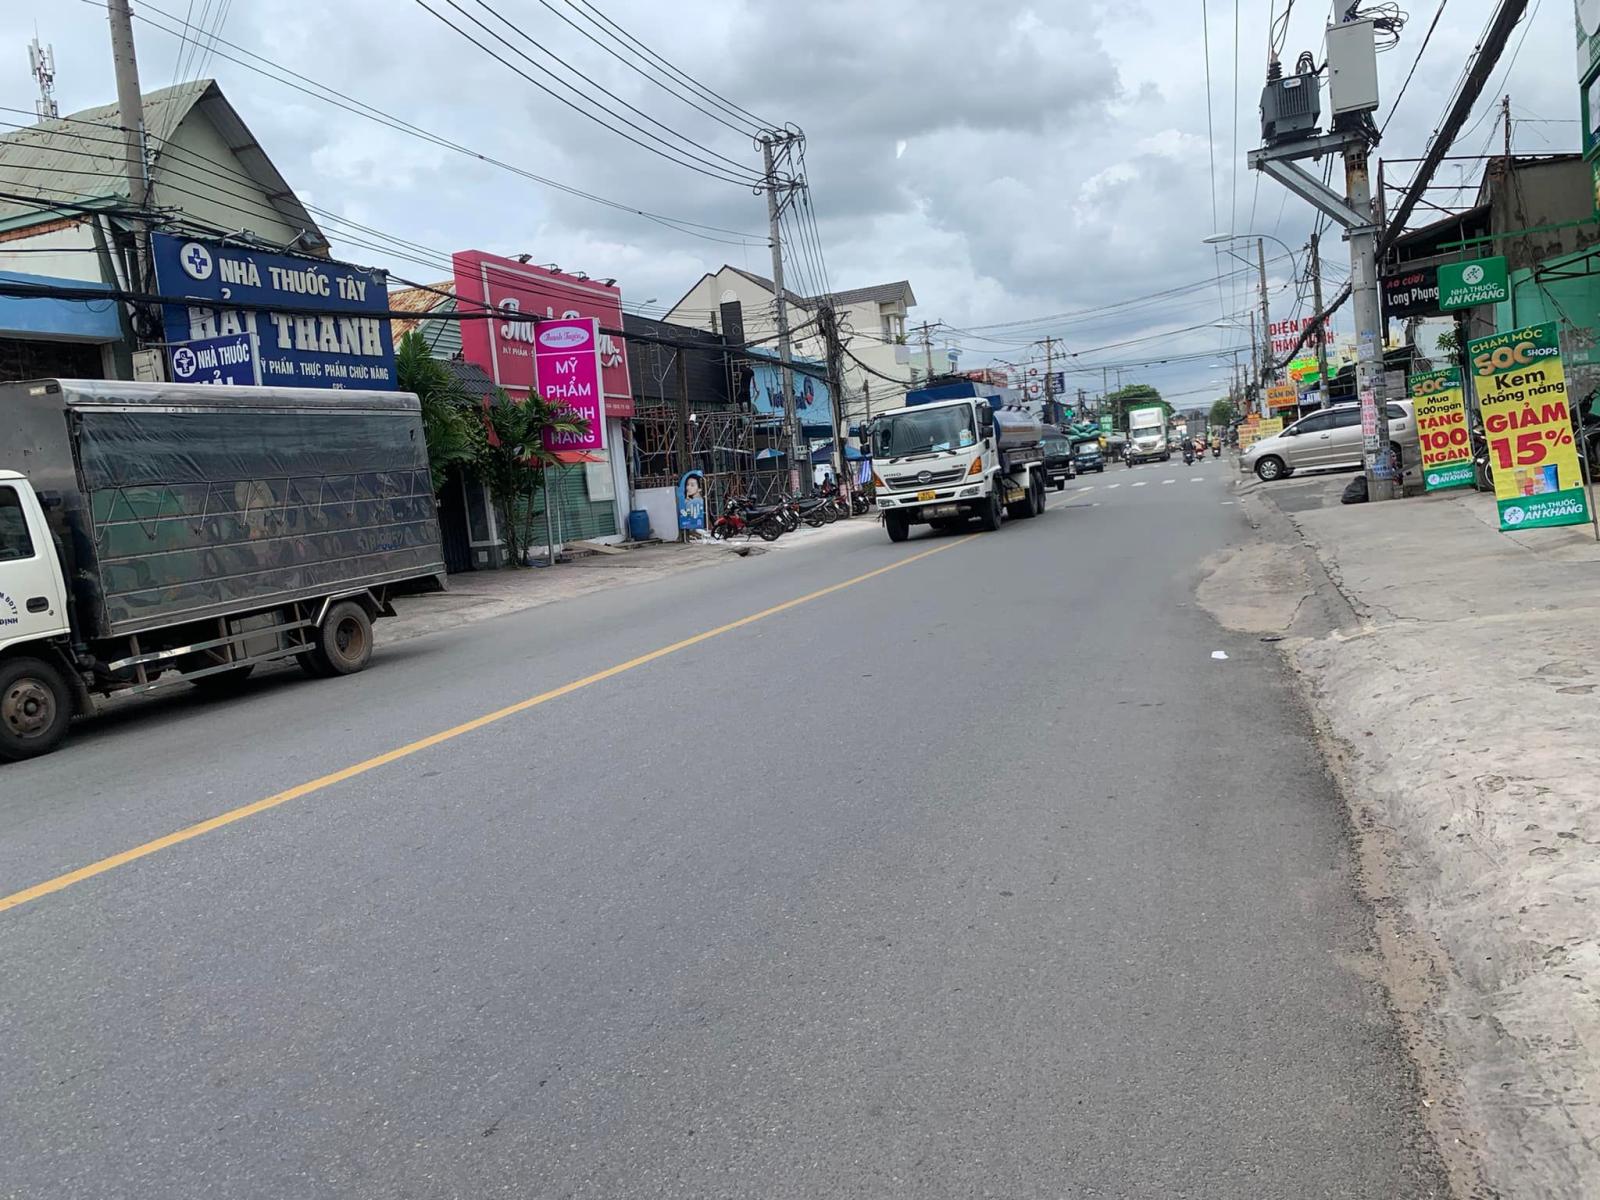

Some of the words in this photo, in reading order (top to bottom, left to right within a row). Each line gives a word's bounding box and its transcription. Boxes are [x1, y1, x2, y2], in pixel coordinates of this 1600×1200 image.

[219, 257, 262, 288] NHÀ
[268, 266, 330, 297] THUỐC
[336, 274, 366, 302] TÂY
[1387, 292, 1410, 306] Long
[1411, 286, 1440, 303] Phụng
[1444, 295, 1462, 306] AN
[1463, 288, 1505, 303] KHANG
[1470, 335, 1509, 354] CHẠM
[1511, 325, 1543, 342] MỐC
[197, 345, 219, 369] NHÀ
[218, 337, 250, 366] THUỐC
[1526, 347, 1558, 357] SHOPS
[269, 356, 294, 375] PHẨM
[300, 361, 321, 379] THỰC
[324, 360, 347, 378] PHẨM
[556, 356, 578, 375] MỸ
[546, 376, 592, 399] PHẨM
[1494, 370, 1546, 391] Kem
[1427, 395, 1449, 405] Mua
[1481, 389, 1525, 406] chống
[1528, 380, 1565, 397] nắng
[1418, 411, 1464, 431] TẶNG
[1485, 401, 1568, 433] GIẢM
[1420, 427, 1468, 452] 100
[1490, 427, 1572, 469] 15%
[1423, 446, 1470, 464] NGÀN
[1524, 510, 1542, 520] AN
[1543, 504, 1583, 518] KHANG
